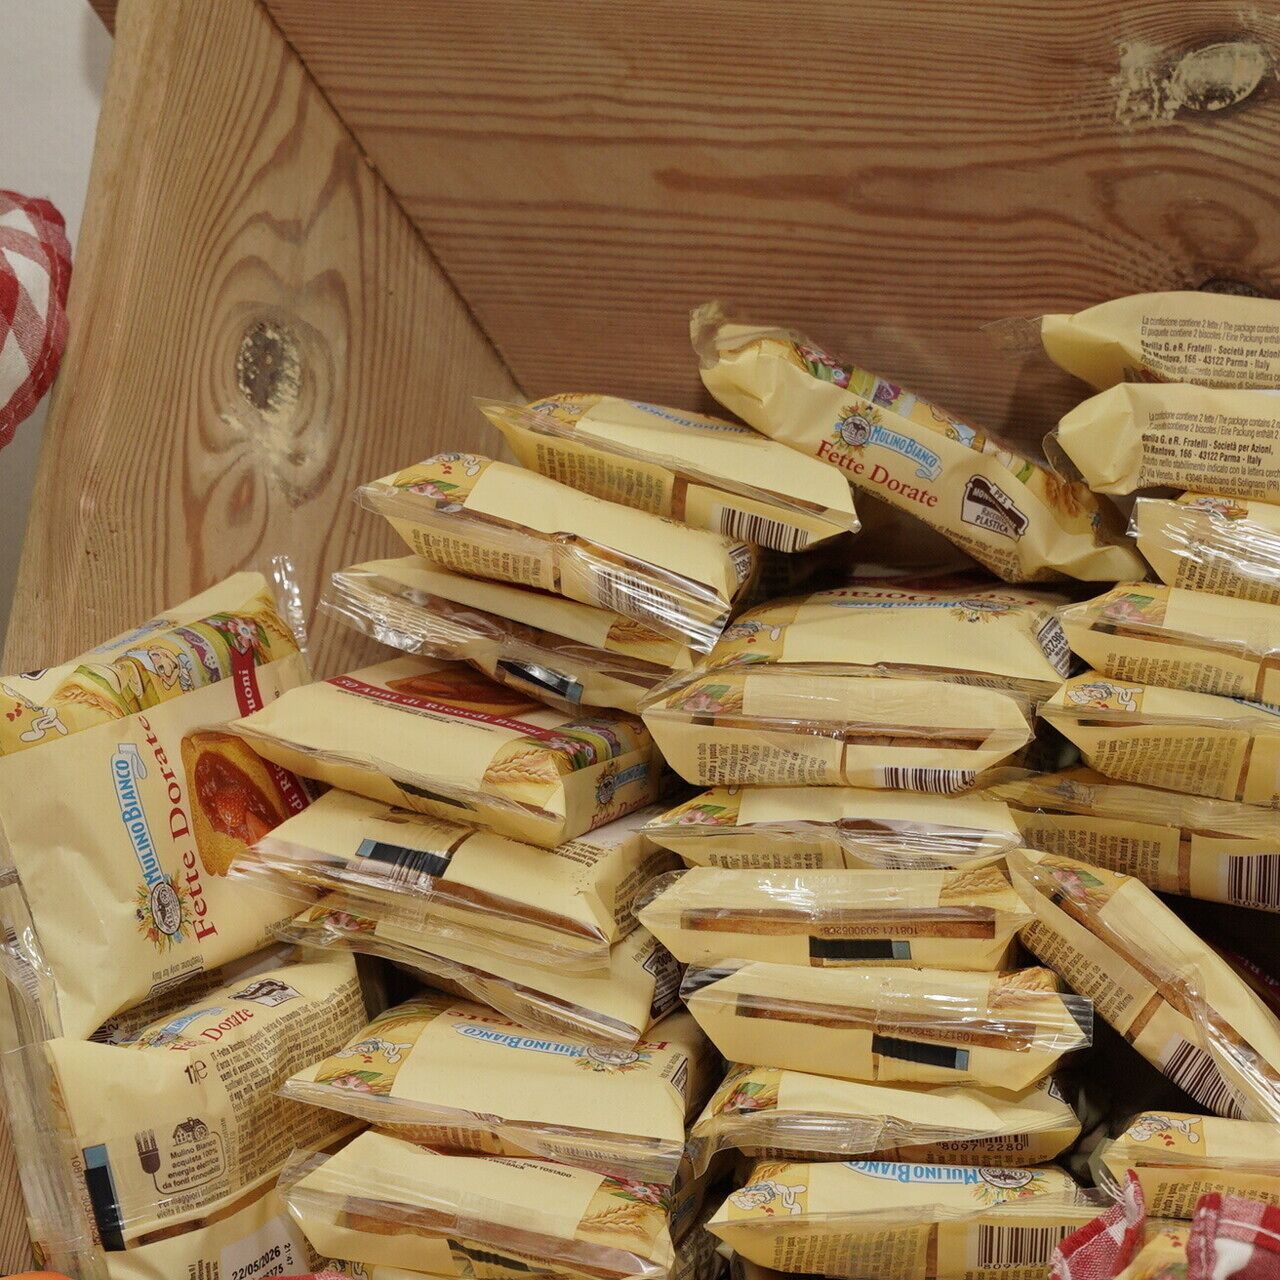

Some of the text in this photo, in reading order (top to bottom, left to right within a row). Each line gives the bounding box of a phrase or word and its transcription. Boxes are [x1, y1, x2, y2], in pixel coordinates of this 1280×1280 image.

[1187, 344, 1212, 354] Fratelli
[1245, 349, 1257, 359] per
[1203, 356, 1224, 366] 43122
[1226, 358, 1248, 368] Parma
[1255, 359, 1270, 370] Italy
[871, 426, 938, 468] MULINO BIANCO
[1183, 437, 1208, 448] Fratelli
[1214, 440, 1237, 450] Società
[1238, 443, 1250, 452] per
[1251, 443, 1274, 454] Azioni,
[1180, 449, 1262, 465] 166 43122 Parma Italy
[816, 440, 939, 507] Fette Dorate
[975, 515, 1009, 534] PLASTICA
[401, 696, 419, 705] di
[425, 703, 490, 721] Ricordi
[495, 719, 544, 736] Buoni
[116, 759, 163, 886] MULINO BIANCO
[138, 716, 218, 944] Fette Dorate
[200, 1006, 254, 1042] Dorate
[463, 1027, 587, 1058] MULINO BIANCO
[170, 1146, 196, 1159] Mulino
[941, 1142, 1024, 1151] 8097 2280
[168, 1166, 196, 1179] energia
[540, 1167, 572, 1178] TOSTADO
[914, 1166, 979, 1186] MULINO
[173, 1178, 190, 1188] fonti
